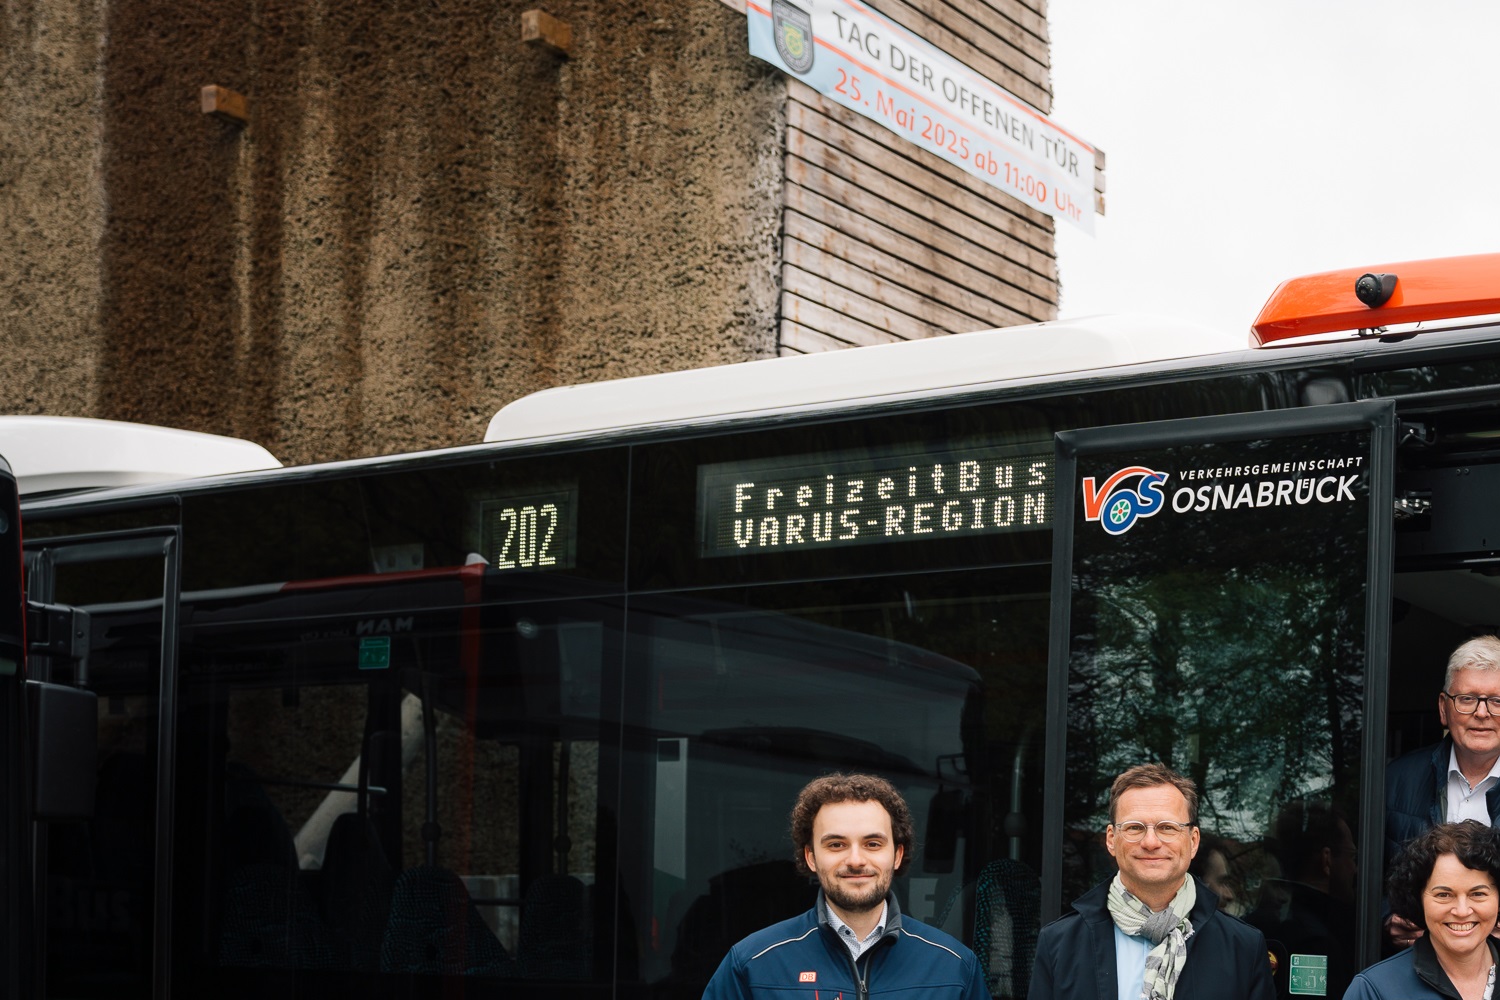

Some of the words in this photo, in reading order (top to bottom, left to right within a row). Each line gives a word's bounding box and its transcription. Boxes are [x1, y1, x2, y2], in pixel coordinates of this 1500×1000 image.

[831, 11, 880, 61] TAG
[889, 43, 935, 93] DER
[942, 76, 1035, 152] OFFENEN
[1040, 132, 1080, 178] TÜR
[834, 67, 869, 106] 25.
[877, 90, 915, 131] Mai
[921, 116, 970, 160] 2025
[974, 150, 998, 176] ab
[1004, 161, 1047, 203] 11:00
[1053, 187, 1082, 222] Uhr
[733, 459, 1047, 512] FreizeitBus
[1171, 474, 1360, 513] OSNABRÜCK
[1179, 456, 1363, 481] VERKEHRSGEMEINSCHAFT
[733, 492, 1047, 549] VARUS-REGION
[1082, 465, 1169, 536] VOS
[498, 503, 558, 570] 202
[800, 972, 815, 982] DB
